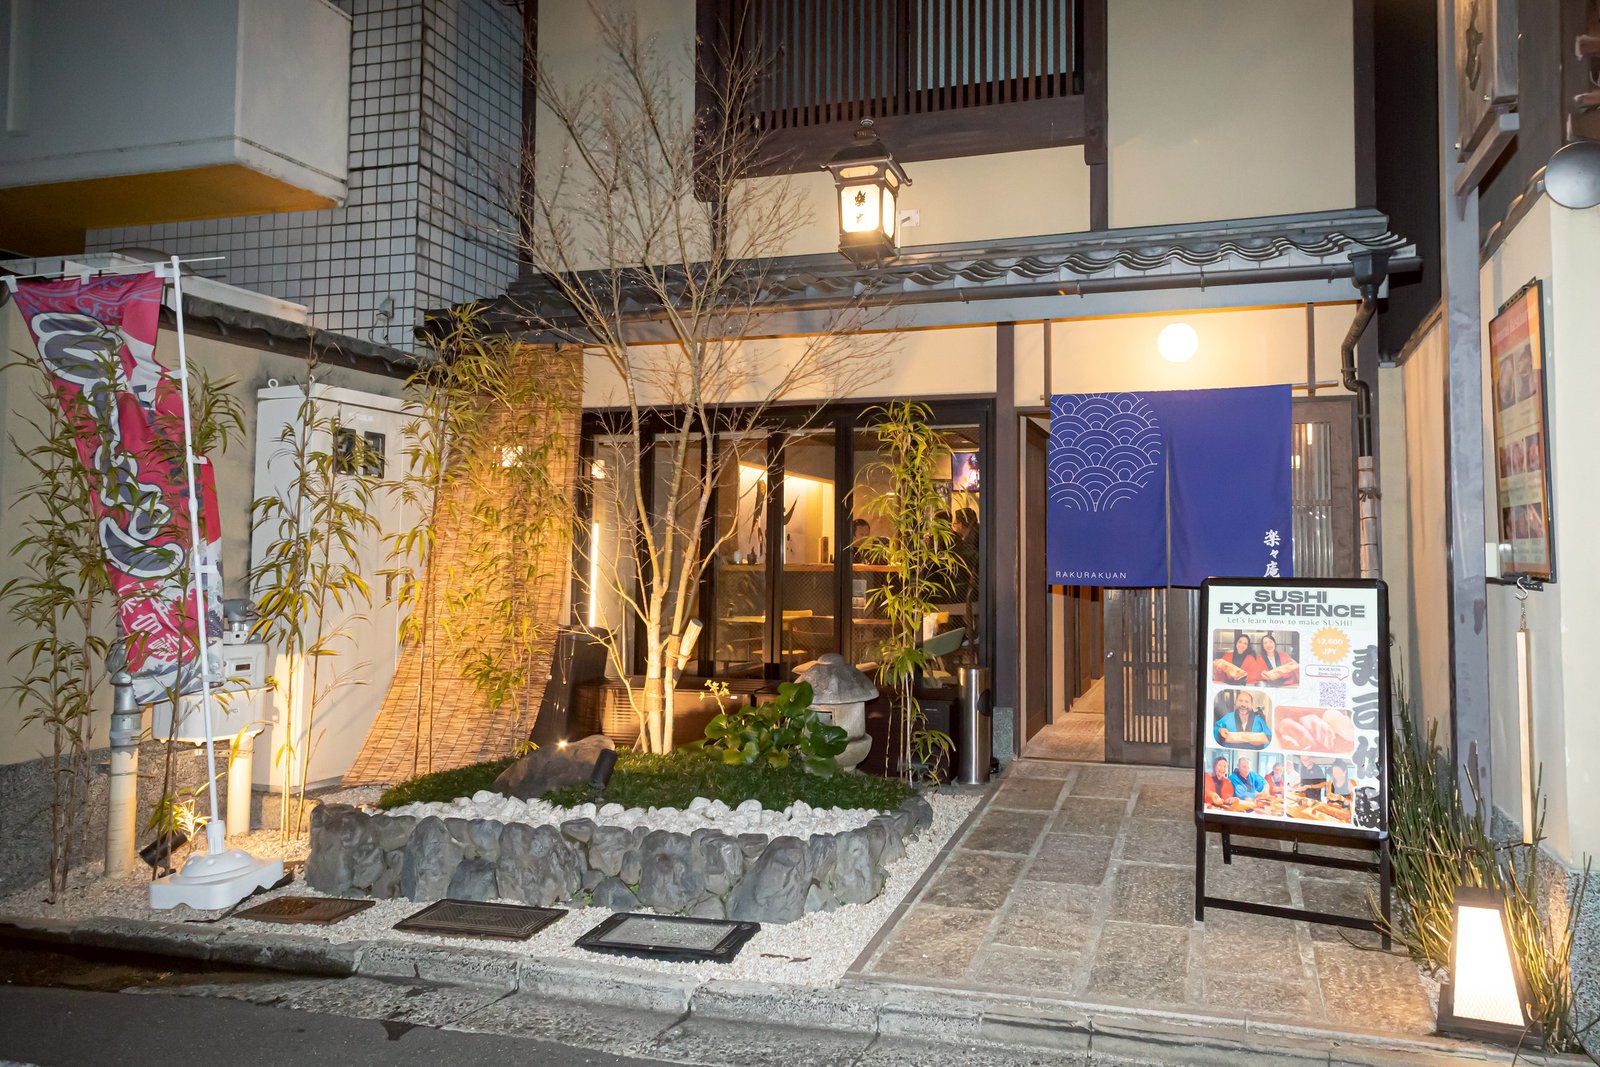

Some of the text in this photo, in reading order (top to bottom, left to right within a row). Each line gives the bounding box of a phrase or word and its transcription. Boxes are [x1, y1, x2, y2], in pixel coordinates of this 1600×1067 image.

[1263, 529, 1281, 578] 楽々庵
[1055, 570, 1128, 580] RAKURAKUAN
[1254, 589, 1328, 604] SUSHI
[1219, 602, 1366, 618] EXPERIENCE
[1227, 616, 1246, 624] Let's
[1247, 617, 1267, 625] learn
[1269, 618, 1285, 626] how
[1298, 619, 1320, 627] make
